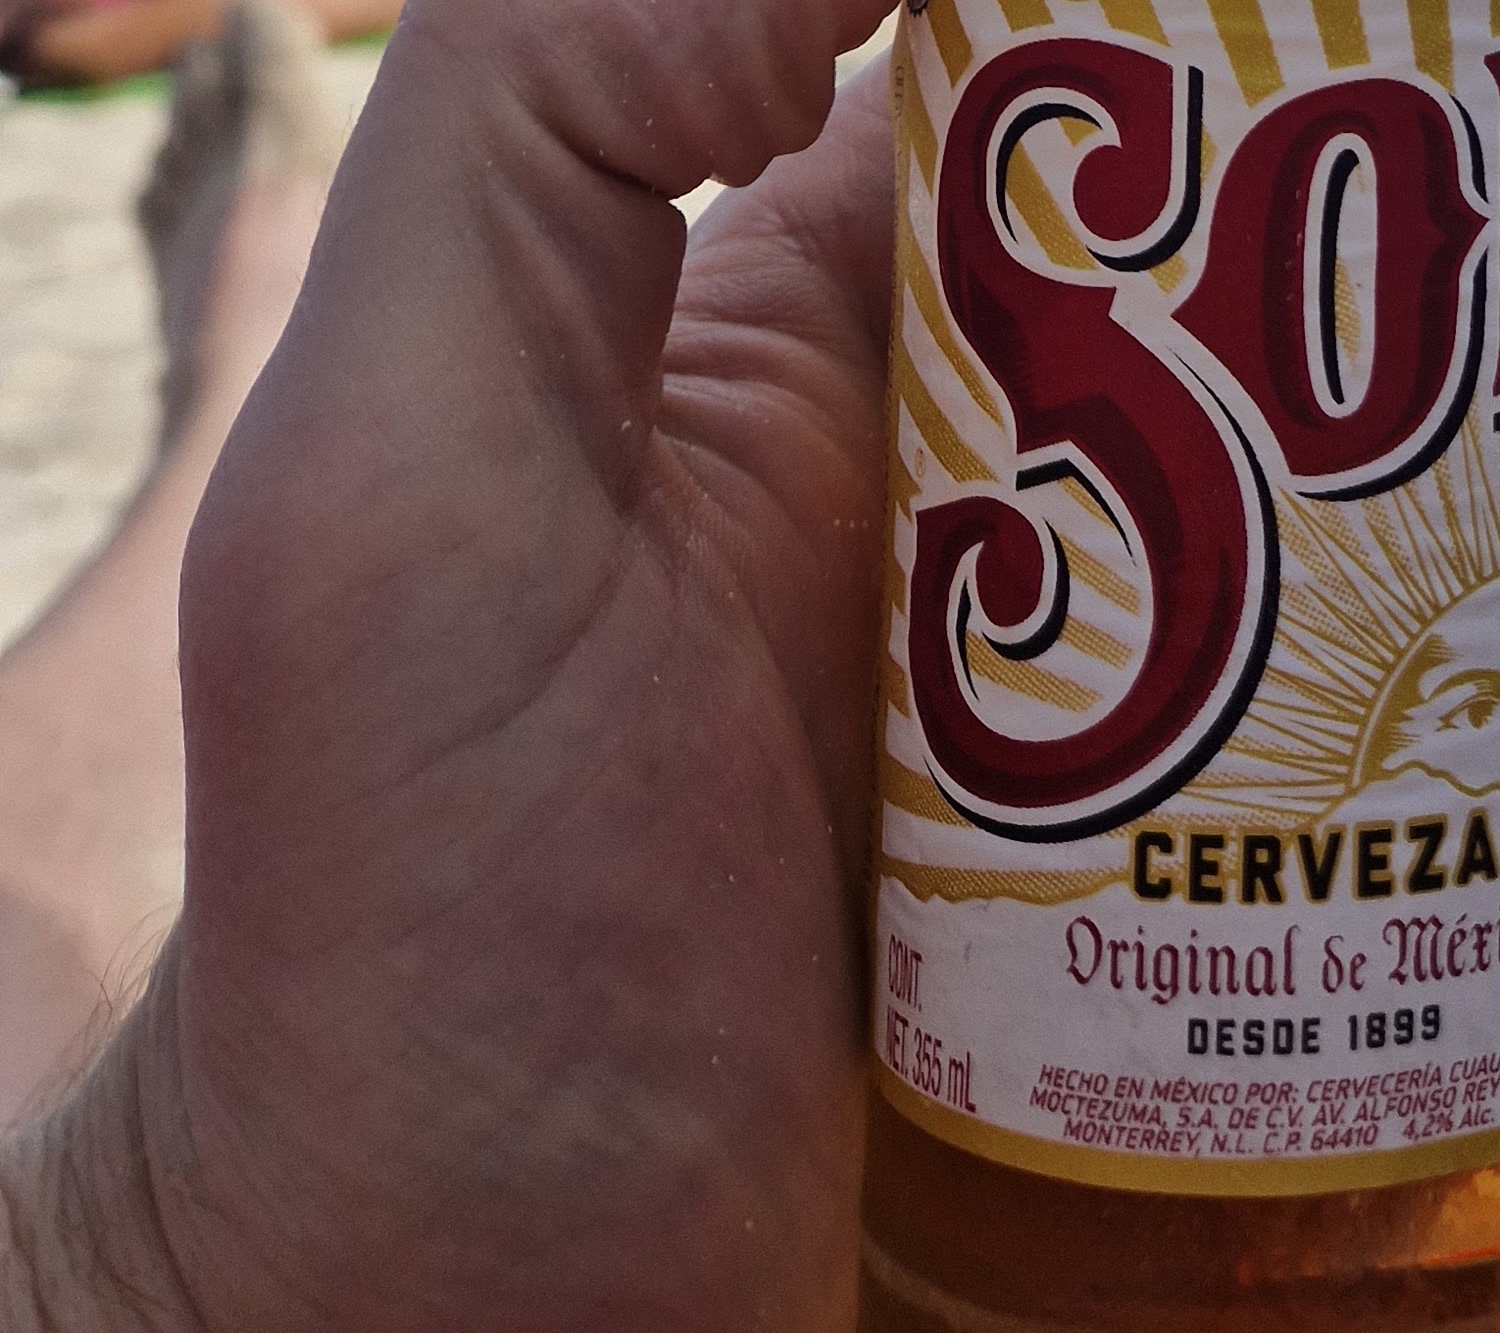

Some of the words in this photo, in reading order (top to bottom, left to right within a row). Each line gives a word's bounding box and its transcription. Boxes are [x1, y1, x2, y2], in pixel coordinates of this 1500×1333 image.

[1133, 808, 1500, 904] CERVEZA
[888, 933, 923, 1013] CONT.
[1065, 914, 1301, 1005] Original
[1322, 935, 1367, 994] de
[885, 1004, 909, 1079] NET.
[912, 1026, 942, 1097] 355
[947, 1050, 977, 1114] mL
[1187, 1017, 1320, 1056] DESDE
[1347, 1004, 1441, 1051] 1899
[1029, 1085, 1167, 1128] MOCTEZUMA,
[1176, 1106, 1218, 1129] S.A.
[1228, 1106, 1259, 1129] DE
[1266, 1105, 1303, 1129] C.V.
[1312, 1101, 1345, 1127] AV.
[1353, 1085, 1457, 1123] ALFONSO
[1039, 1064, 1109, 1097] HECHO
[1114, 1076, 1144, 1100] EN
[1150, 1076, 1238, 1105] MÉXICO
[1245, 1082, 1299, 1105] POR:
[1306, 1061, 1443, 1103] CERVECERÍA
[1063, 1118, 1200, 1157] MONTERREY,
[1210, 1133, 1252, 1154] N.L.
[1263, 1130, 1303, 1154] C.P.
[1310, 1123, 1379, 1151] 64410
[1457, 1102, 1495, 1130] Alc.
